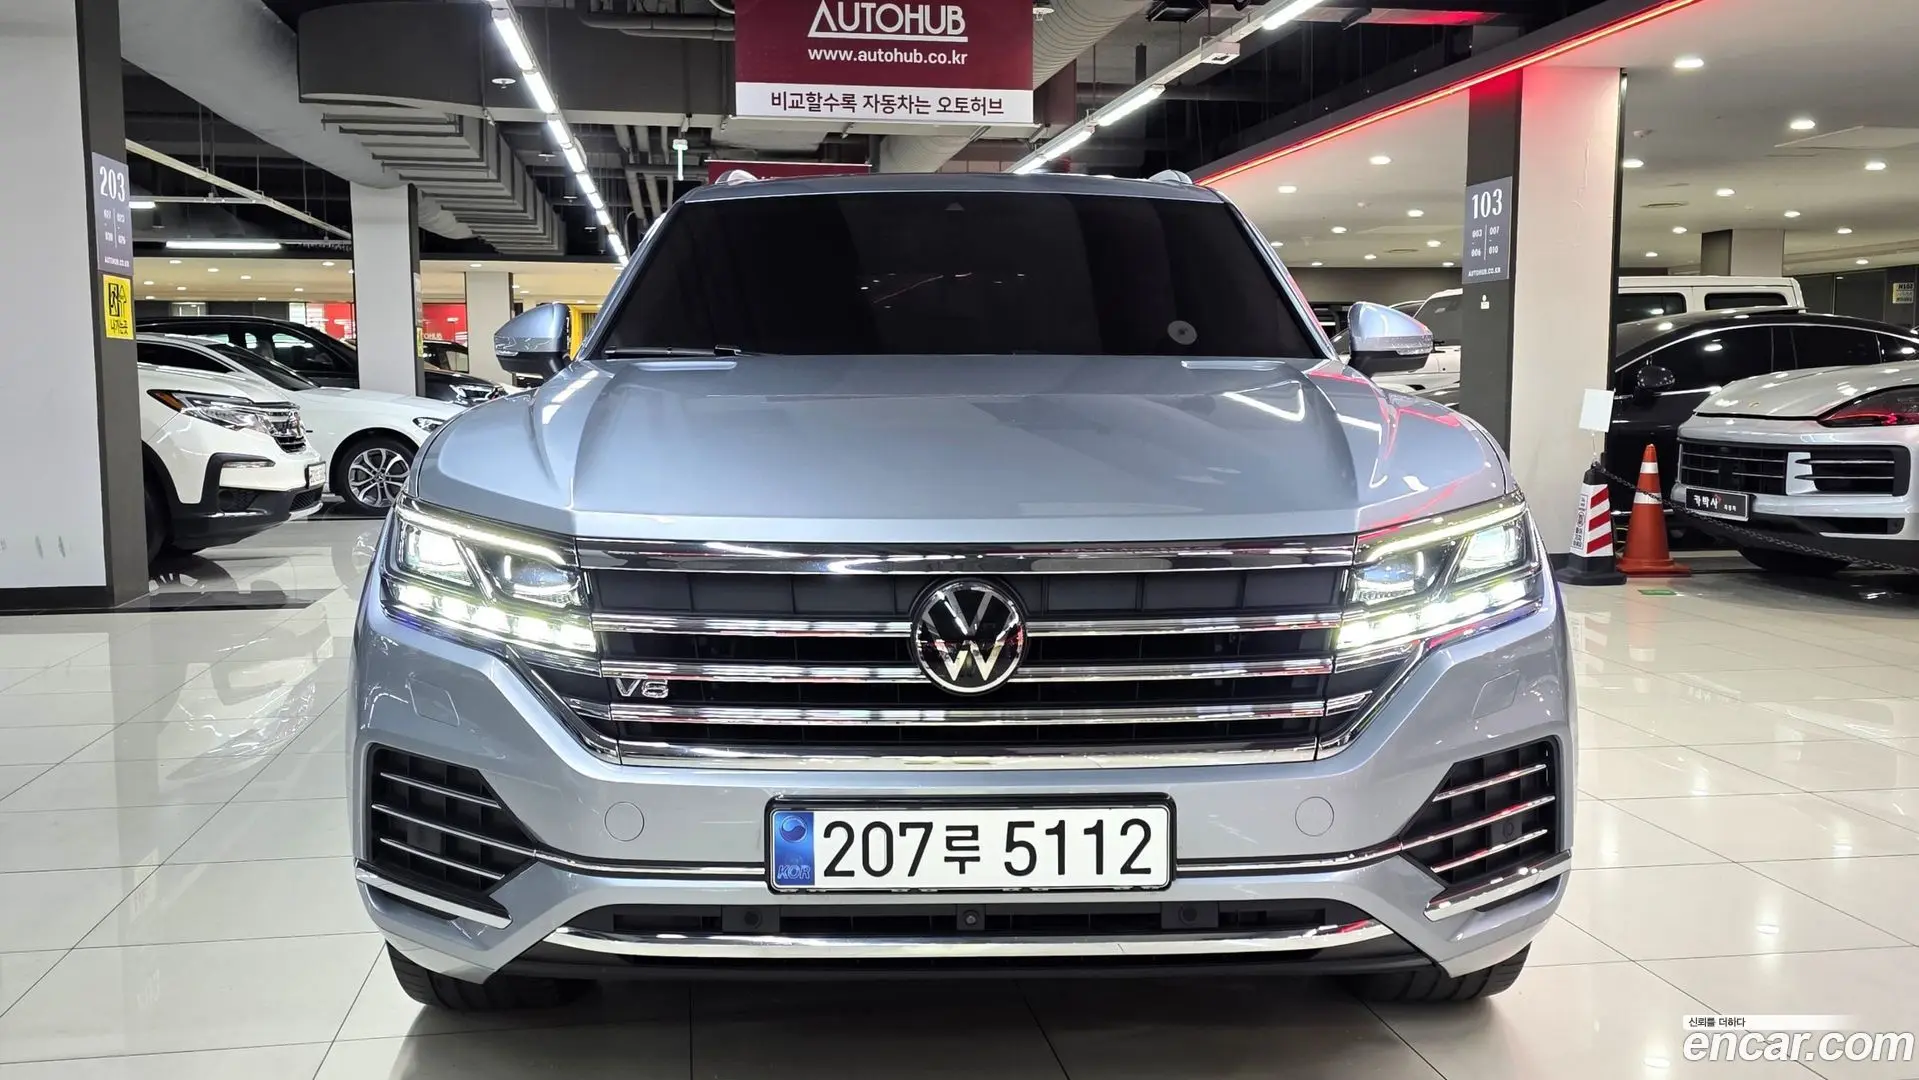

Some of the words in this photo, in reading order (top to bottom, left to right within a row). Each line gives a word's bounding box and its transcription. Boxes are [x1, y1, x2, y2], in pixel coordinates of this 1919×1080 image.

[808, 0, 968, 42] AUTOHUB
[808, 48, 968, 65] www.autohub.co.kr
[771, 91, 857, 113] 비교할수록
[863, 94, 932, 115] 자동차는
[936, 96, 1004, 116] 오토허브
[100, 166, 126, 202] 203
[1471, 188, 1503, 219] 103
[1489, 226, 1500, 235] 007
[822, 820, 981, 878] 207루
[1004, 818, 1152, 876] 5112
[777, 864, 811, 880] KOR
